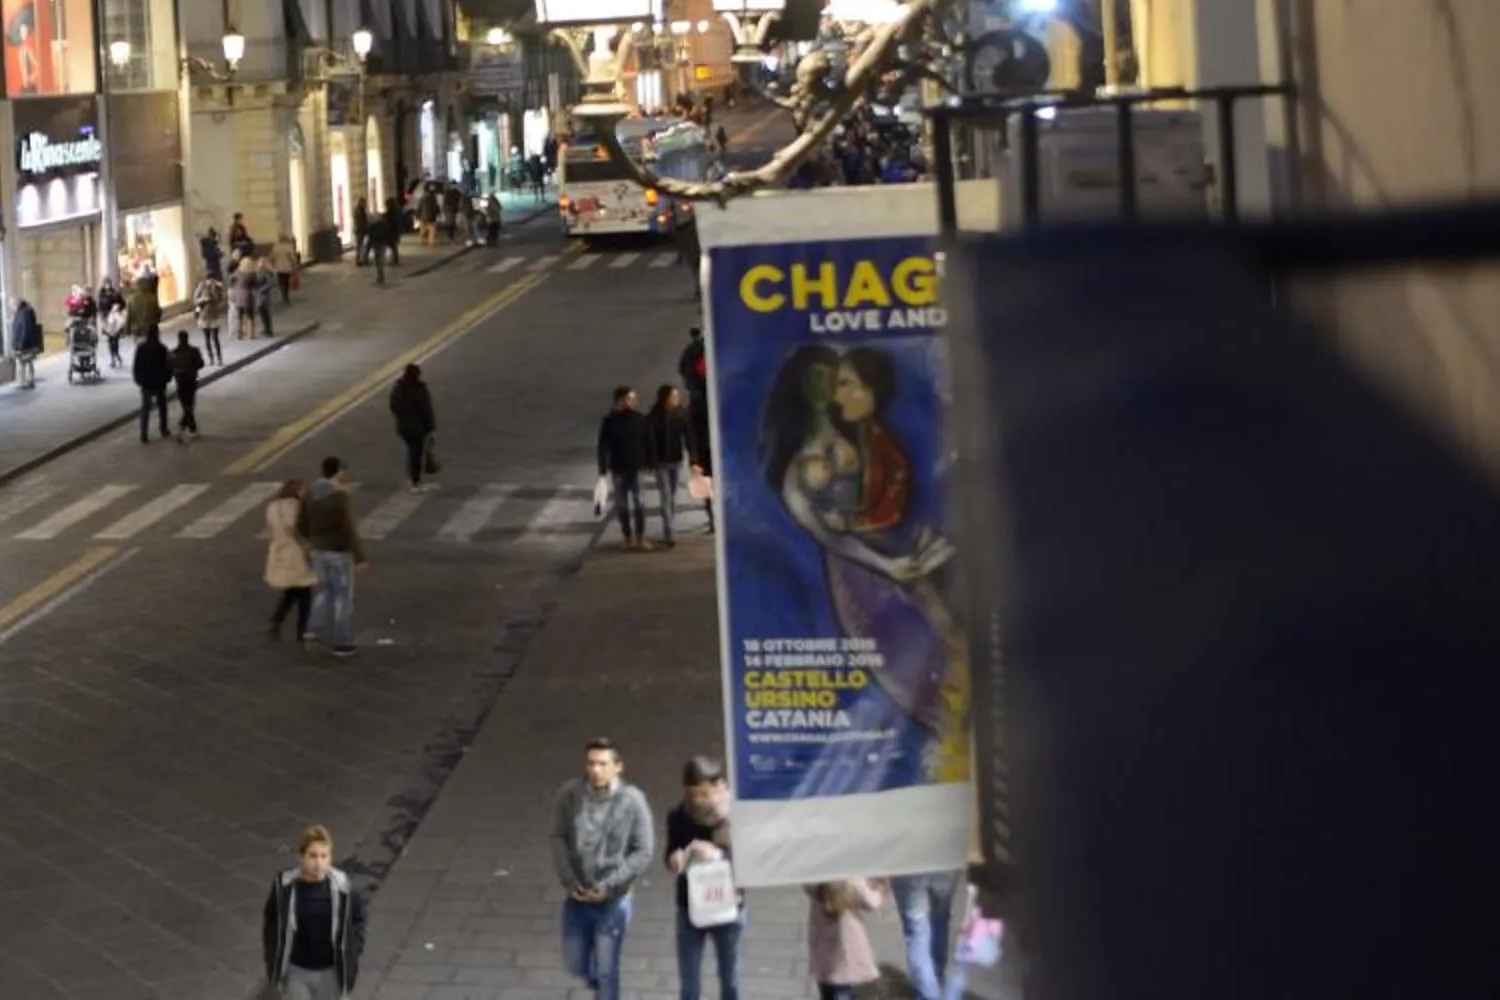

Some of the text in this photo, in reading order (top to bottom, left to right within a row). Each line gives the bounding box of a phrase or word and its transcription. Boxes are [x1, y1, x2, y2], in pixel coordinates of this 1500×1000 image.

[739, 256, 937, 313] CHAG
[809, 307, 947, 333] LOVE AND
[763, 638, 837, 651] OTTOBRE
[764, 654, 844, 667] FEBBRAIO
[744, 670, 868, 690] CASTELLO
[745, 690, 837, 709] URSINO
[745, 709, 851, 729] CATANIA
